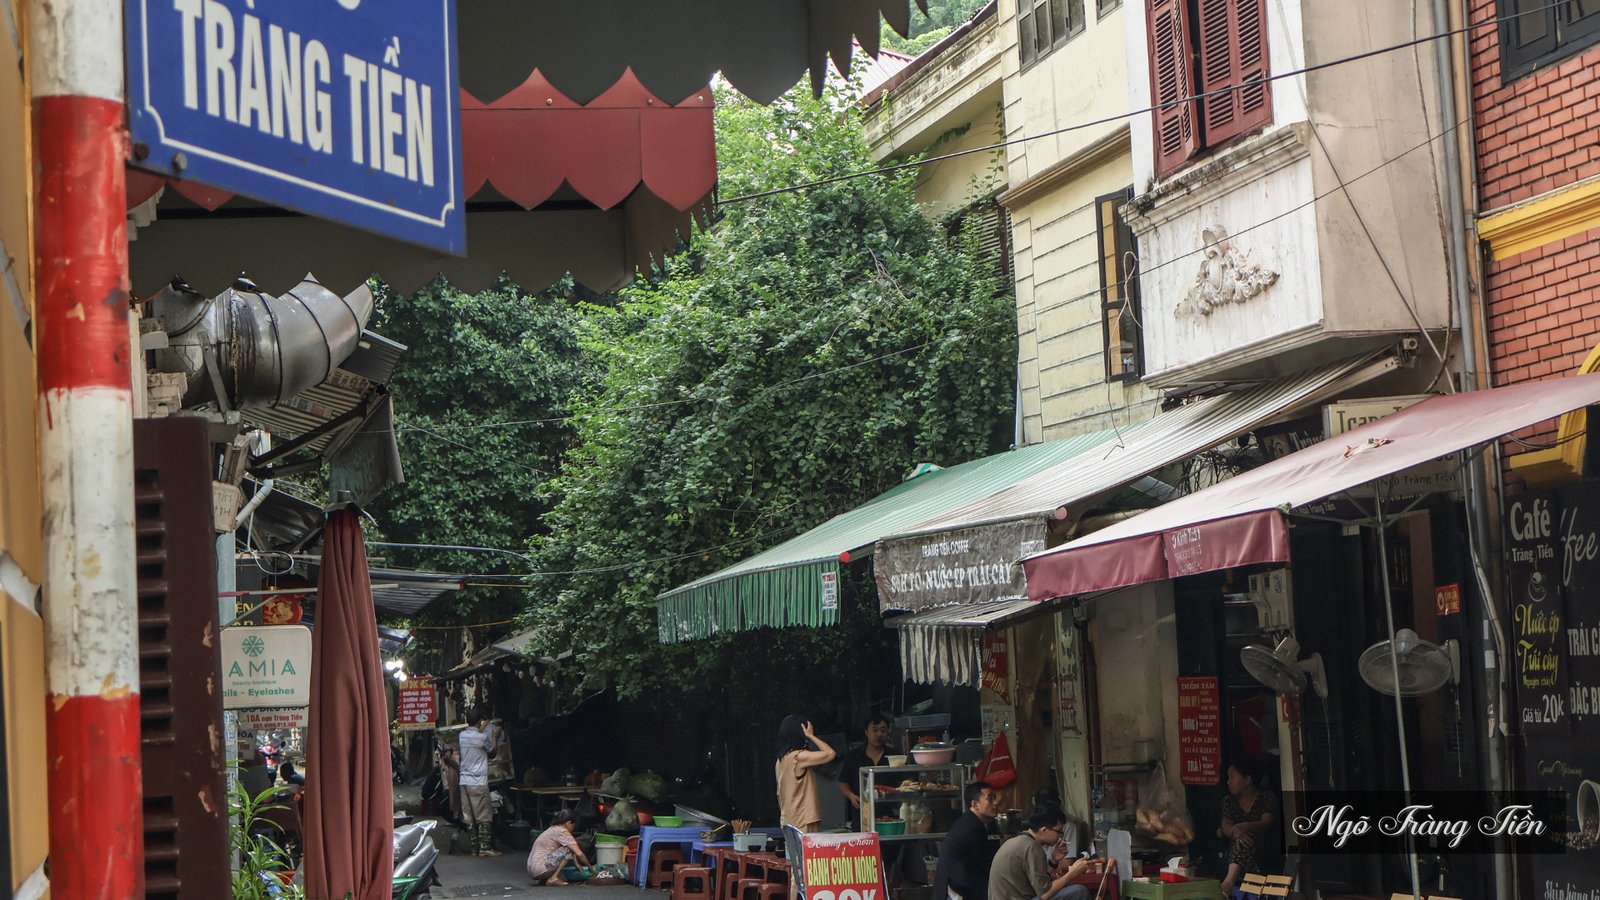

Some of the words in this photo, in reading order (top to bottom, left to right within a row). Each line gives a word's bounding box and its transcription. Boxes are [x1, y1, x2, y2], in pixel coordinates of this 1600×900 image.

[343, 35, 435, 188] TIỀN
[1510, 498, 1551, 541] Café
[1512, 548, 1534, 563] Tràng
[1514, 603, 1546, 636] Nước
[1567, 622, 1590, 656] TRÁI
[228, 659, 296, 678] AMIA
[1516, 639, 1541, 673] Trái
[1541, 647, 1558, 685] cây
[248, 687, 295, 698] Eyelashes
[1522, 707, 1534, 724] Giá
[1542, 694, 1564, 724] 20k
[1570, 681, 1589, 720] ĐẶC
[807, 852, 829, 886] BÁNH
[832, 846, 853, 885] CUỐN
[855, 850, 878, 884] NÓNG
